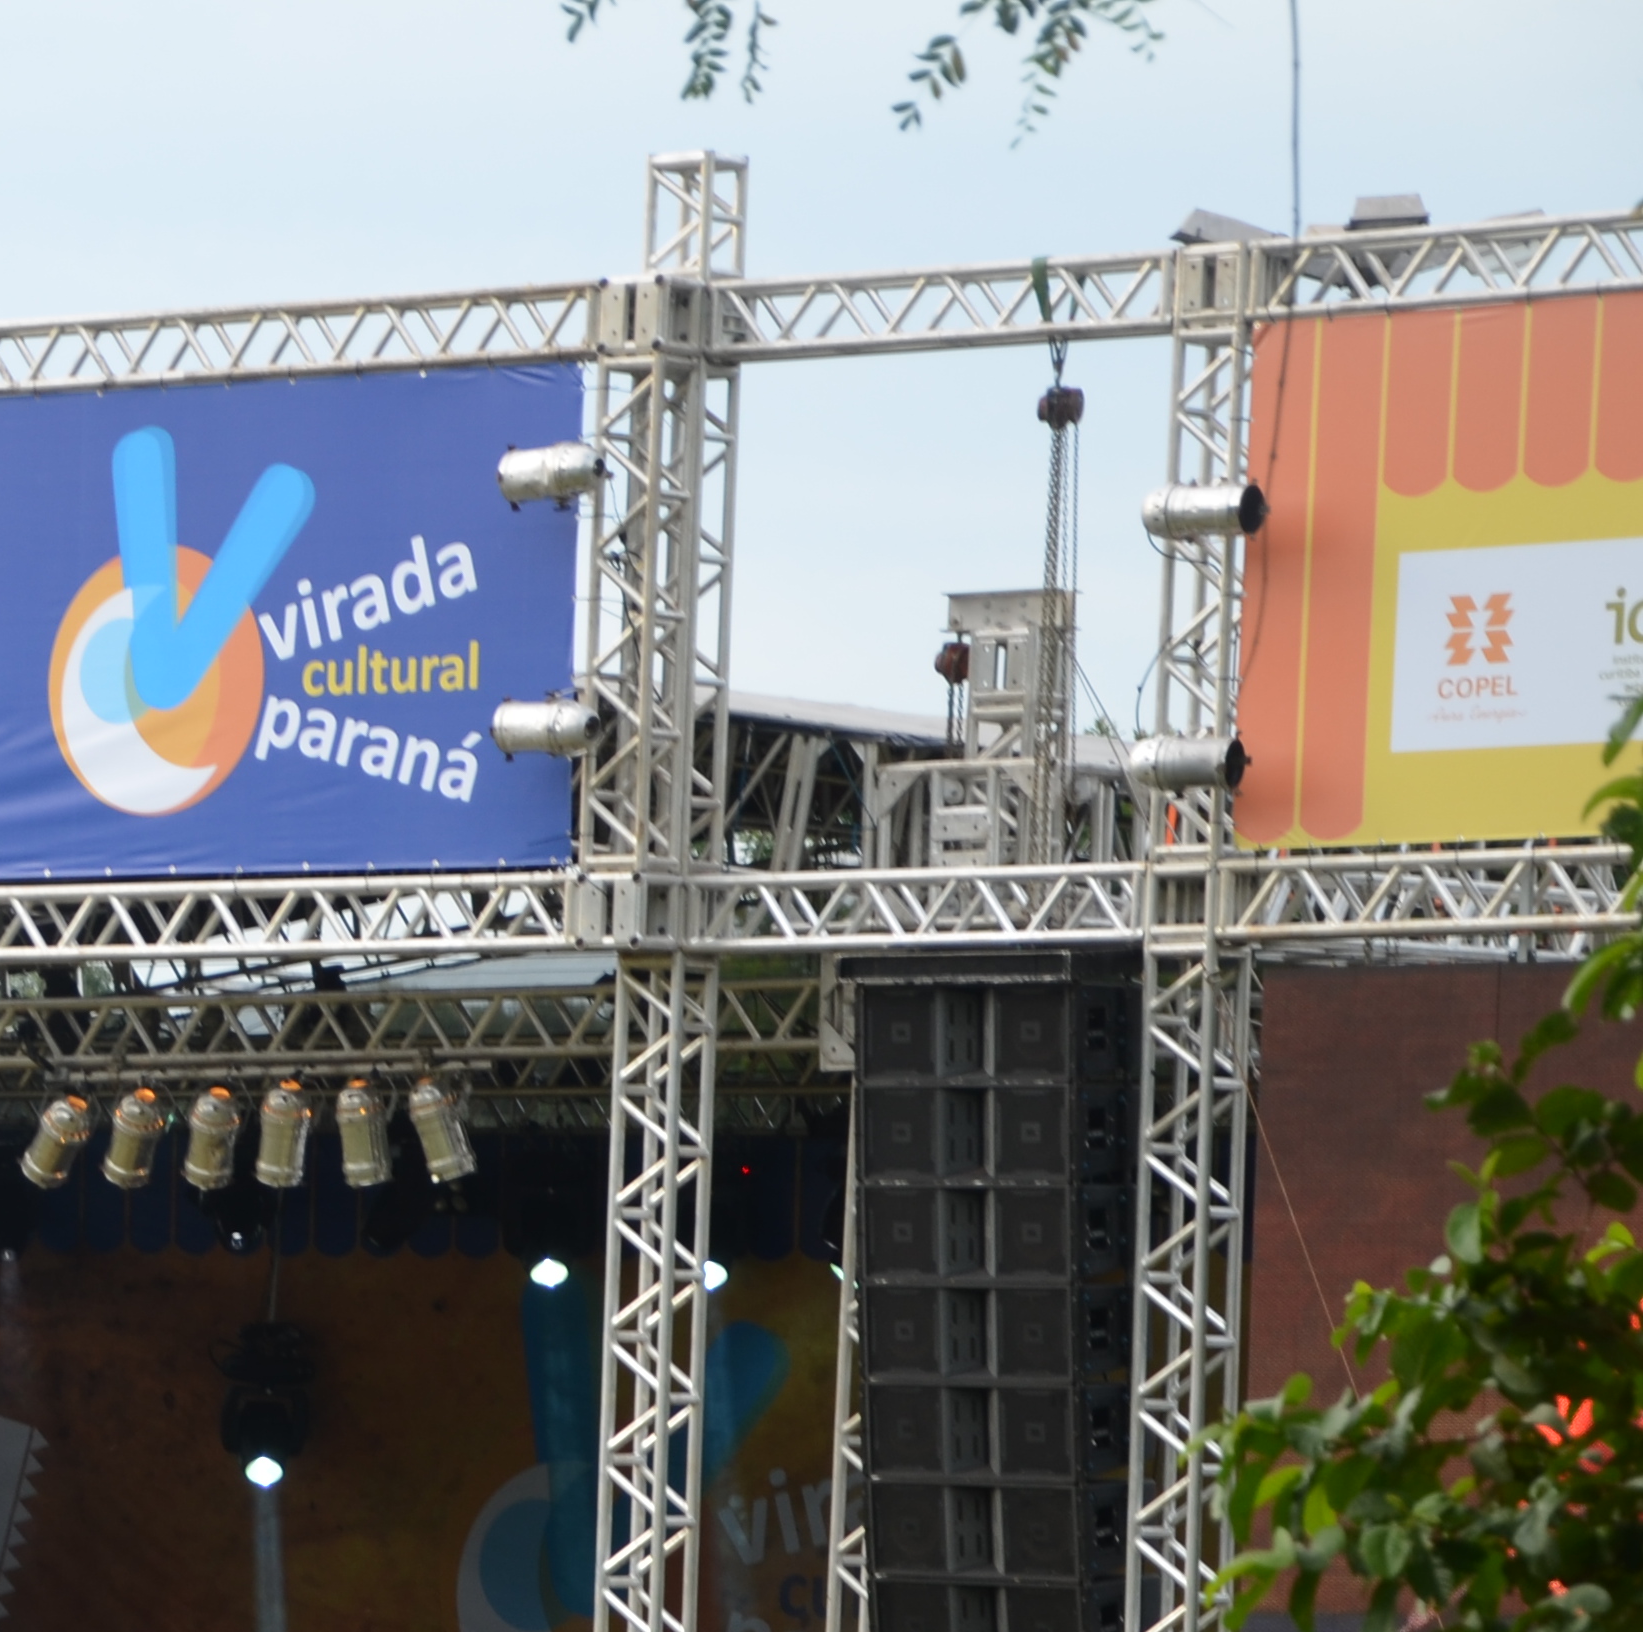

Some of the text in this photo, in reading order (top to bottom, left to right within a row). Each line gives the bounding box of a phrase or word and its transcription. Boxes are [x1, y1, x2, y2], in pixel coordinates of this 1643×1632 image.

[258, 534, 478, 660] virada
[302, 639, 479, 696] cultural
[1437, 675, 1519, 700] COPEL
[255, 694, 482, 802] paraná
